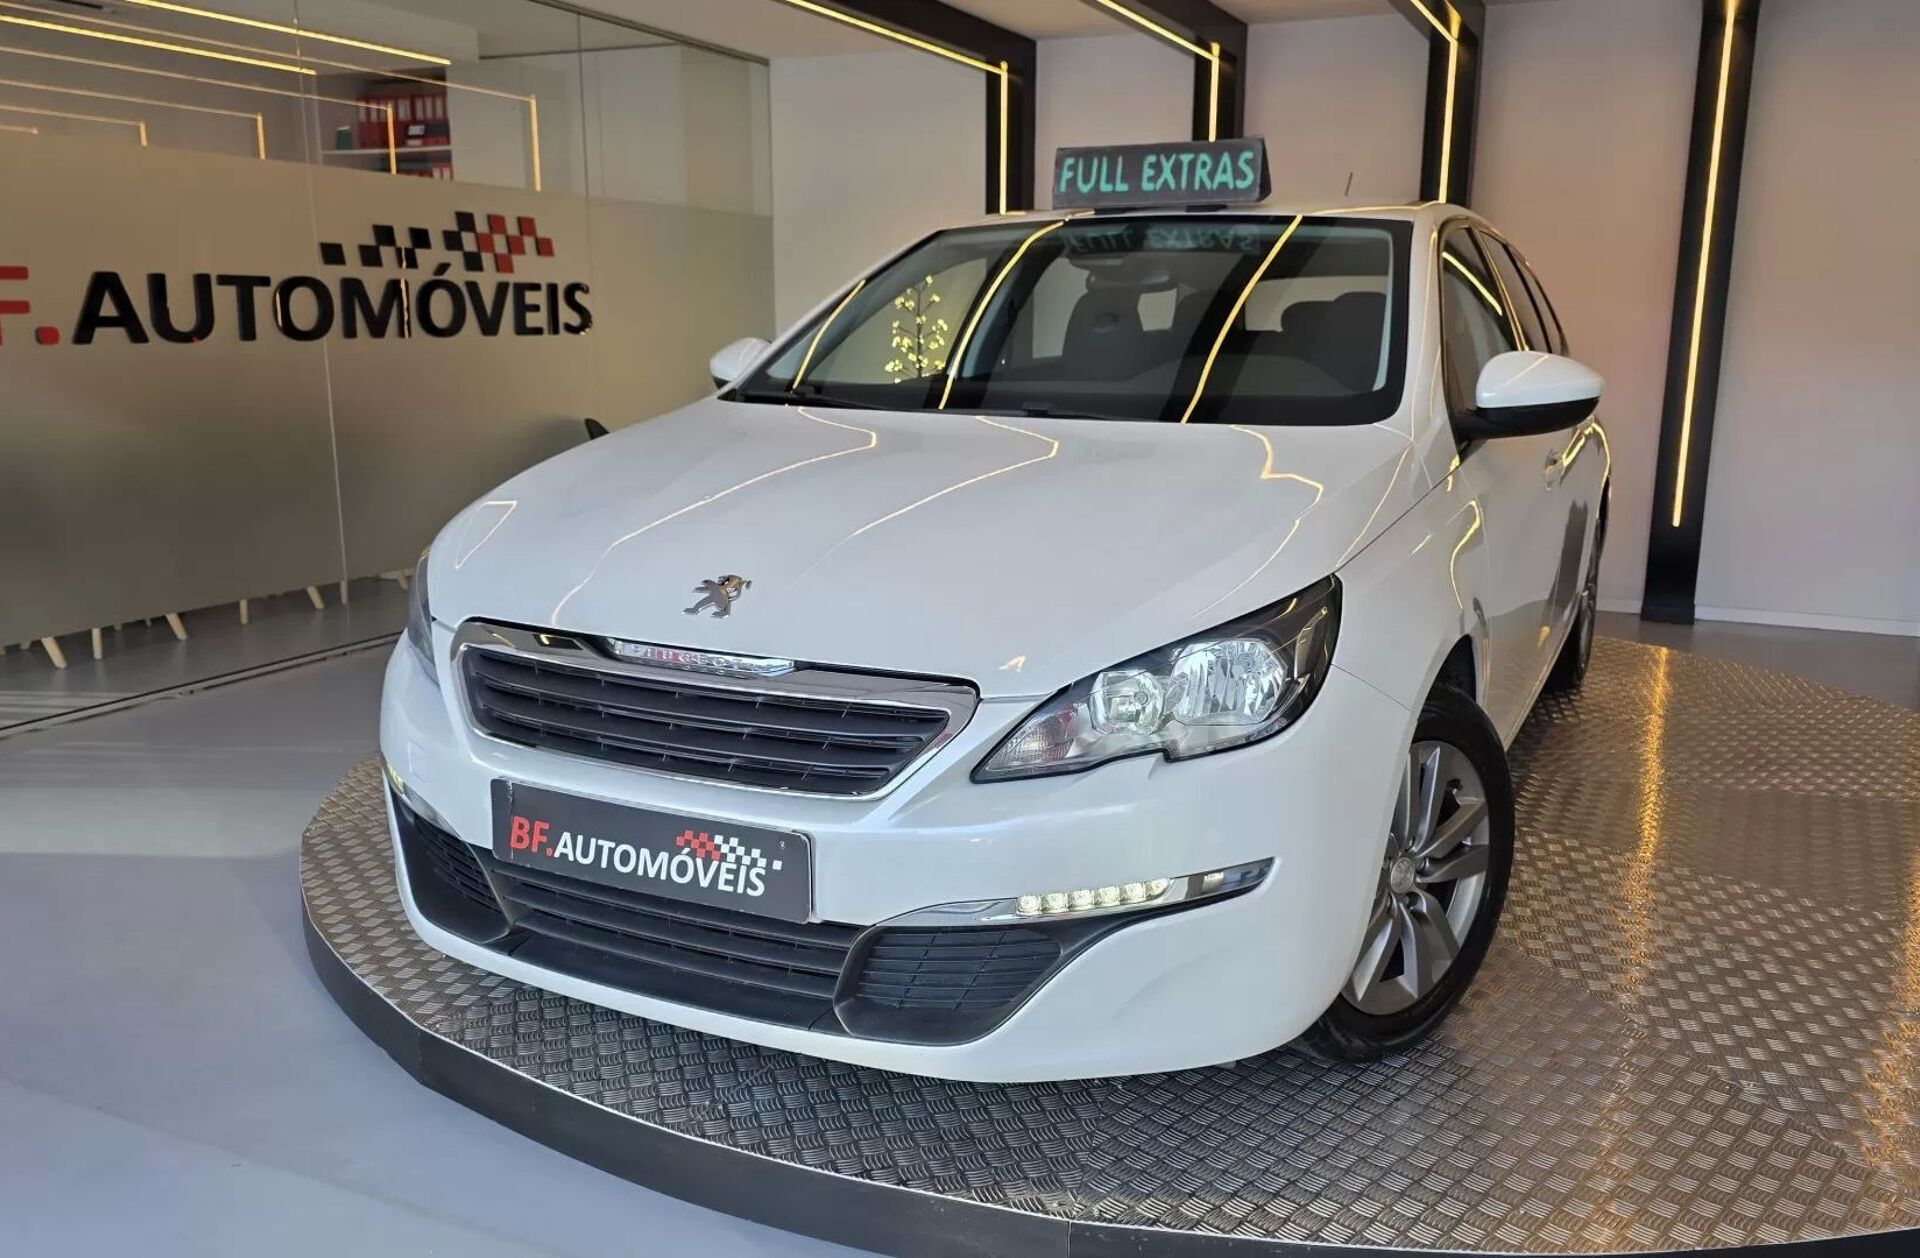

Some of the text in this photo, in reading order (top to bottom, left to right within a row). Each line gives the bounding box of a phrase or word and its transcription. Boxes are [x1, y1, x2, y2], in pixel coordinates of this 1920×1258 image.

[1058, 151, 1255, 192] FULL EXTRAS
[509, 815, 767, 897] BF.AUTOMÓVEIS
